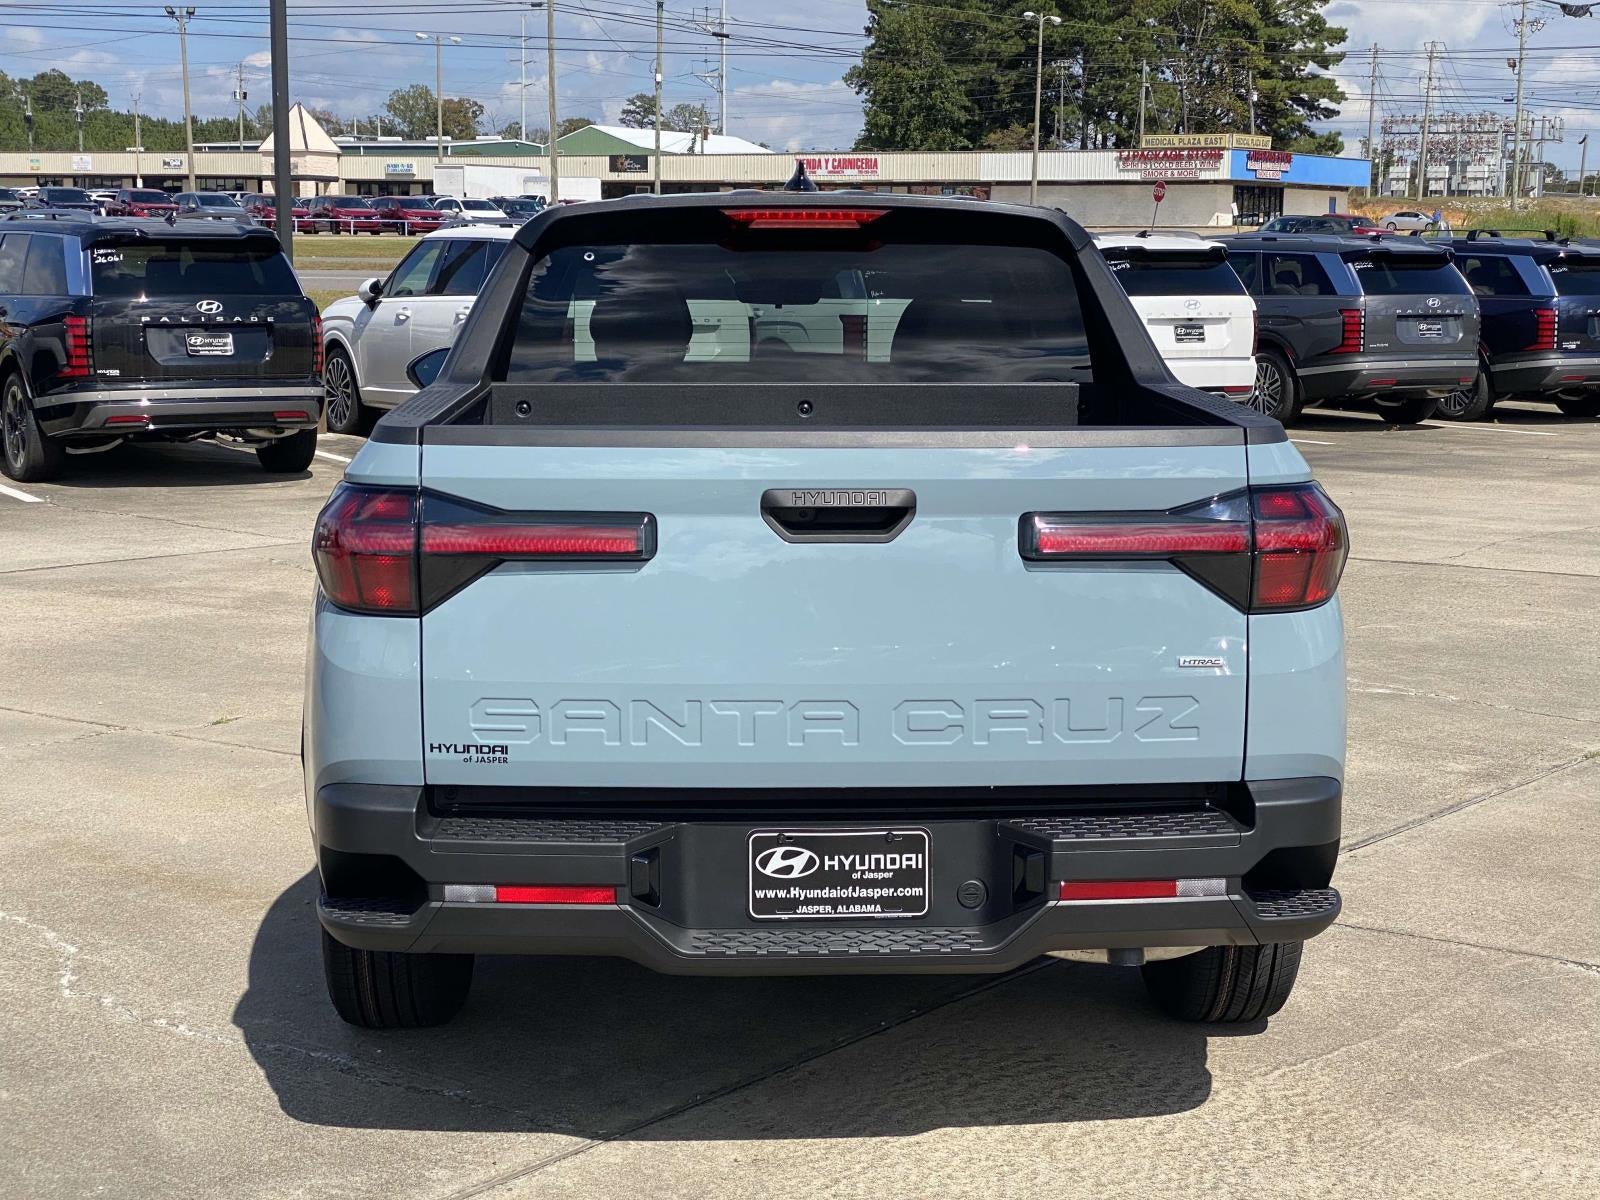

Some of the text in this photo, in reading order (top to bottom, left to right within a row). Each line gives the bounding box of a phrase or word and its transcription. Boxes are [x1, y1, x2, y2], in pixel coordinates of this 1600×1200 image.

[1144, 136, 1223, 146] MEDICAL PLAZA EAST
[1133, 149, 1185, 160] PACKAGE
[1187, 148, 1224, 160] STORE
[824, 158, 830, 170] Y
[831, 157, 878, 170] CARNICERIA
[1121, 161, 1148, 169] SPIRITS
[1153, 187, 1165, 196] STOP
[792, 491, 887, 505] HYUNDAI
[469, 695, 1200, 747] SANTA CRUZ
[429, 743, 509, 755] HYUNDAI
[463, 755, 509, 764] of JASPER
[824, 853, 923, 871] HYUNDAI
[852, 871, 893, 880] of Jasper
[755, 886, 923, 900] www.HyundaiofJasper.com
[796, 904, 882, 914] JASPER, ALABAMA
